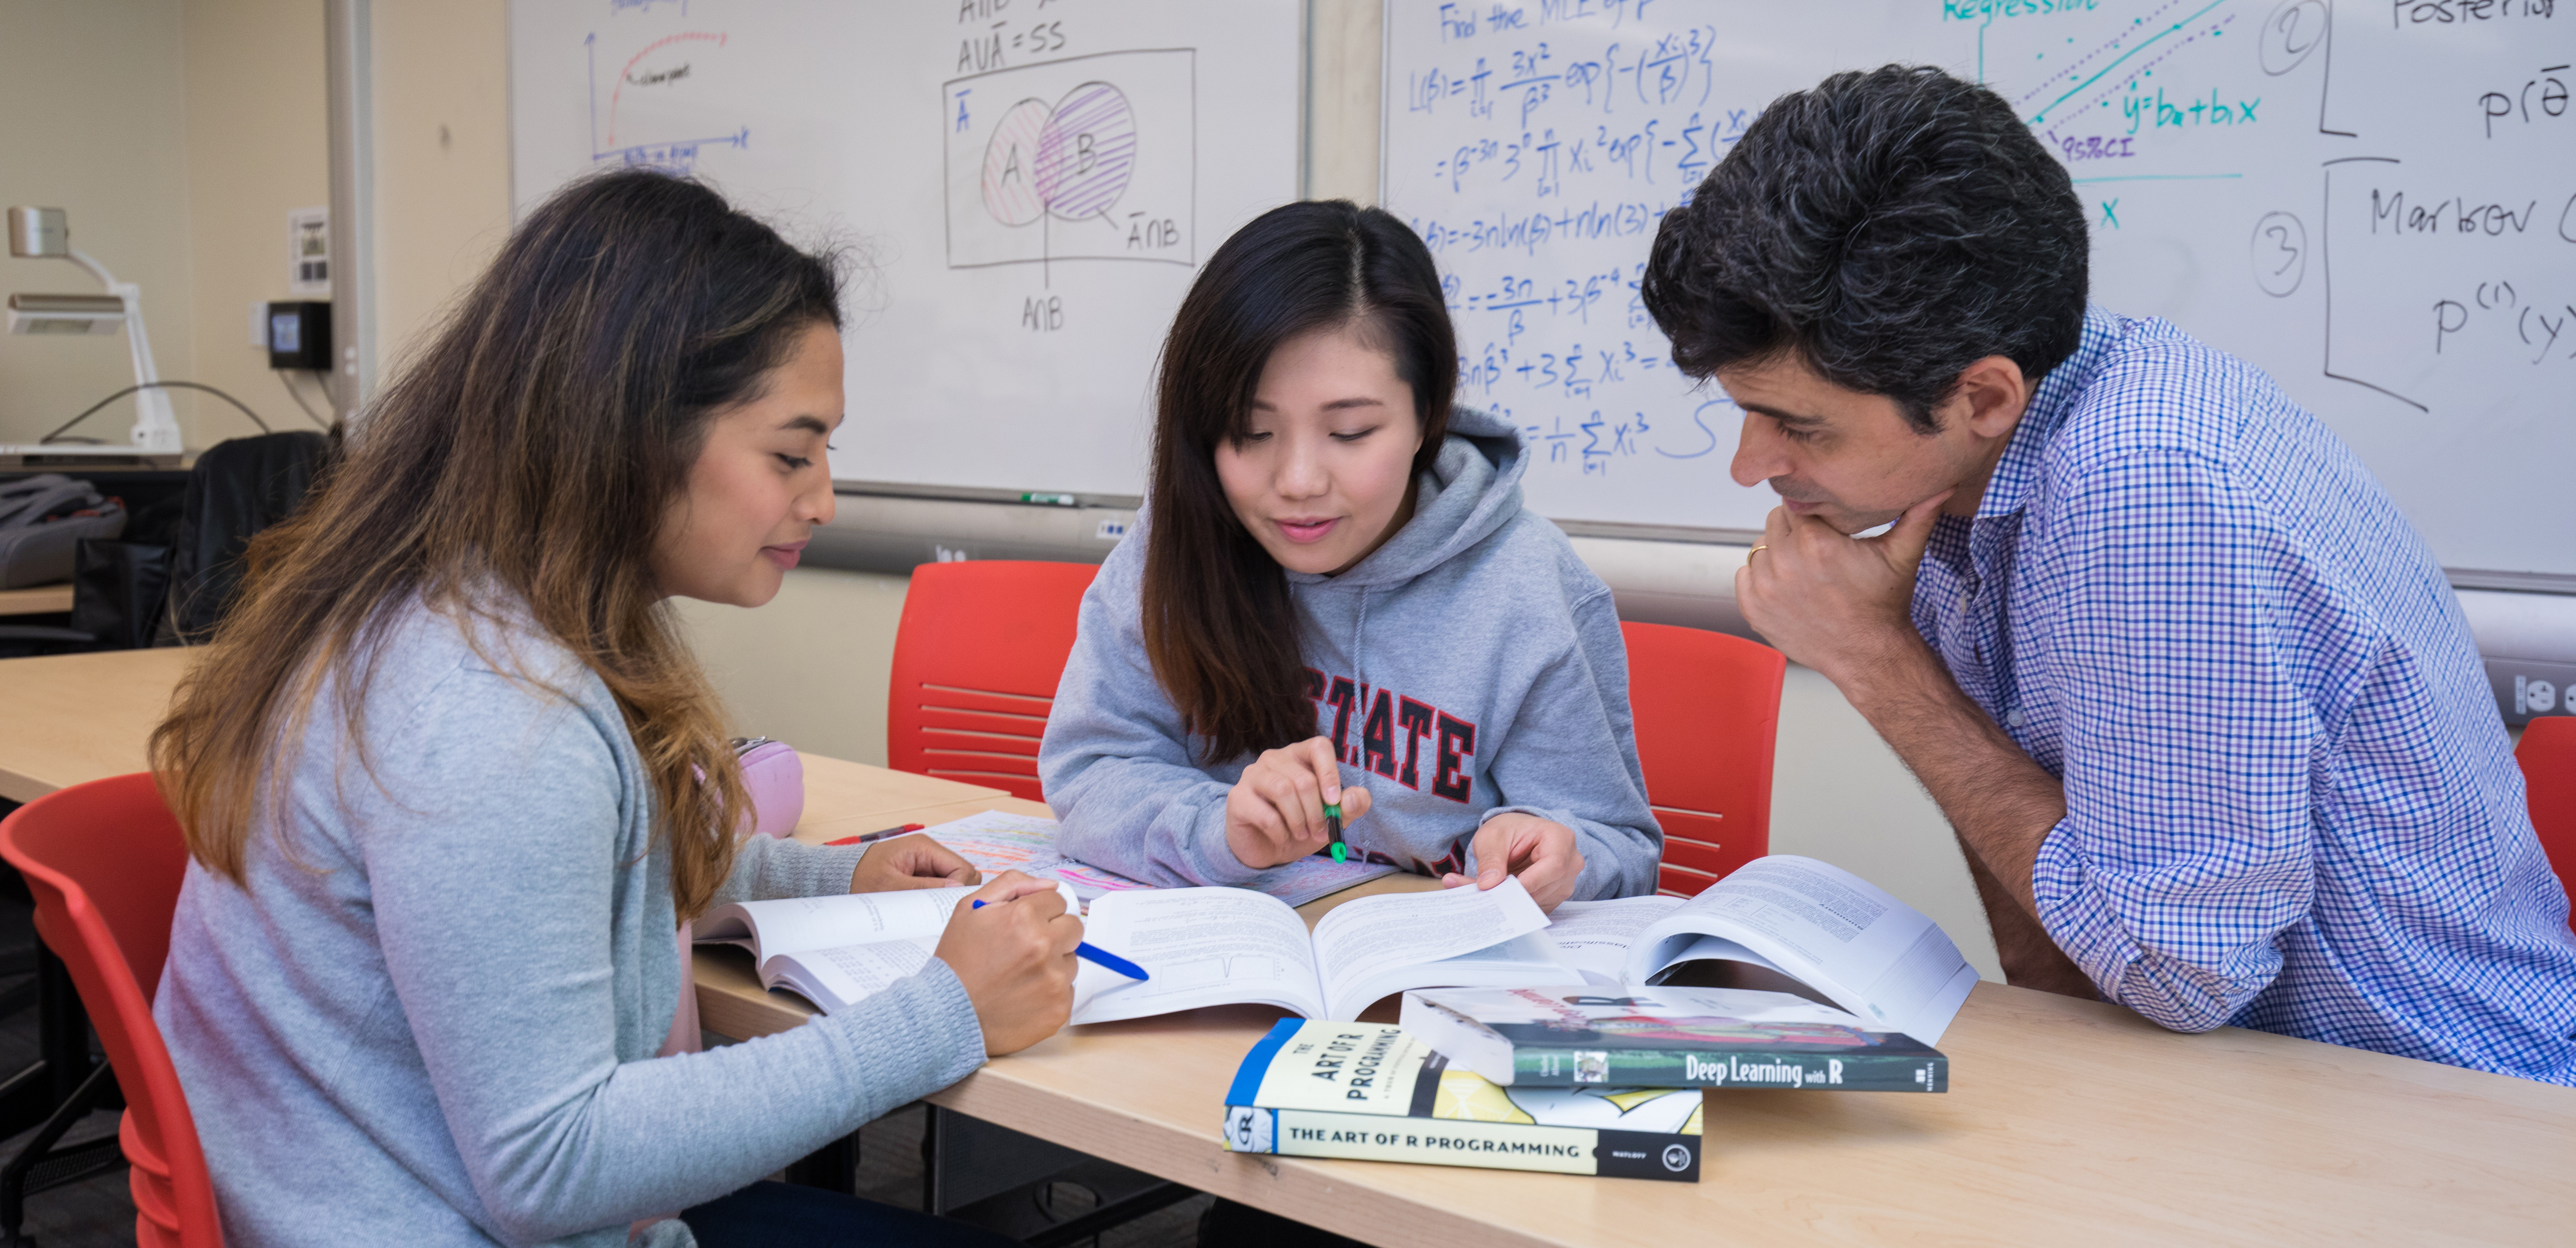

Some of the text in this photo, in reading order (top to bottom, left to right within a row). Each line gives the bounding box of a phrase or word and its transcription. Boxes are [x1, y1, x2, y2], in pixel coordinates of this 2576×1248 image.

[1439, 2, 1477, 44] Find
[1487, 6, 1530, 33] the
[1001, 143, 1021, 190] A
[1076, 133, 1096, 176] B
[2371, 189, 2536, 236] Markov
[1293, 1043, 1314, 1054] THE
[1327, 1041, 1357, 1052] OF
[1346, 1029, 1401, 1101] PROGRAMMING
[1311, 1053, 1346, 1082] ART
[1686, 1055, 1843, 1088] Deep Learning with R
[1290, 1127, 1579, 1158] THE ART OF R PROGRAMMING
